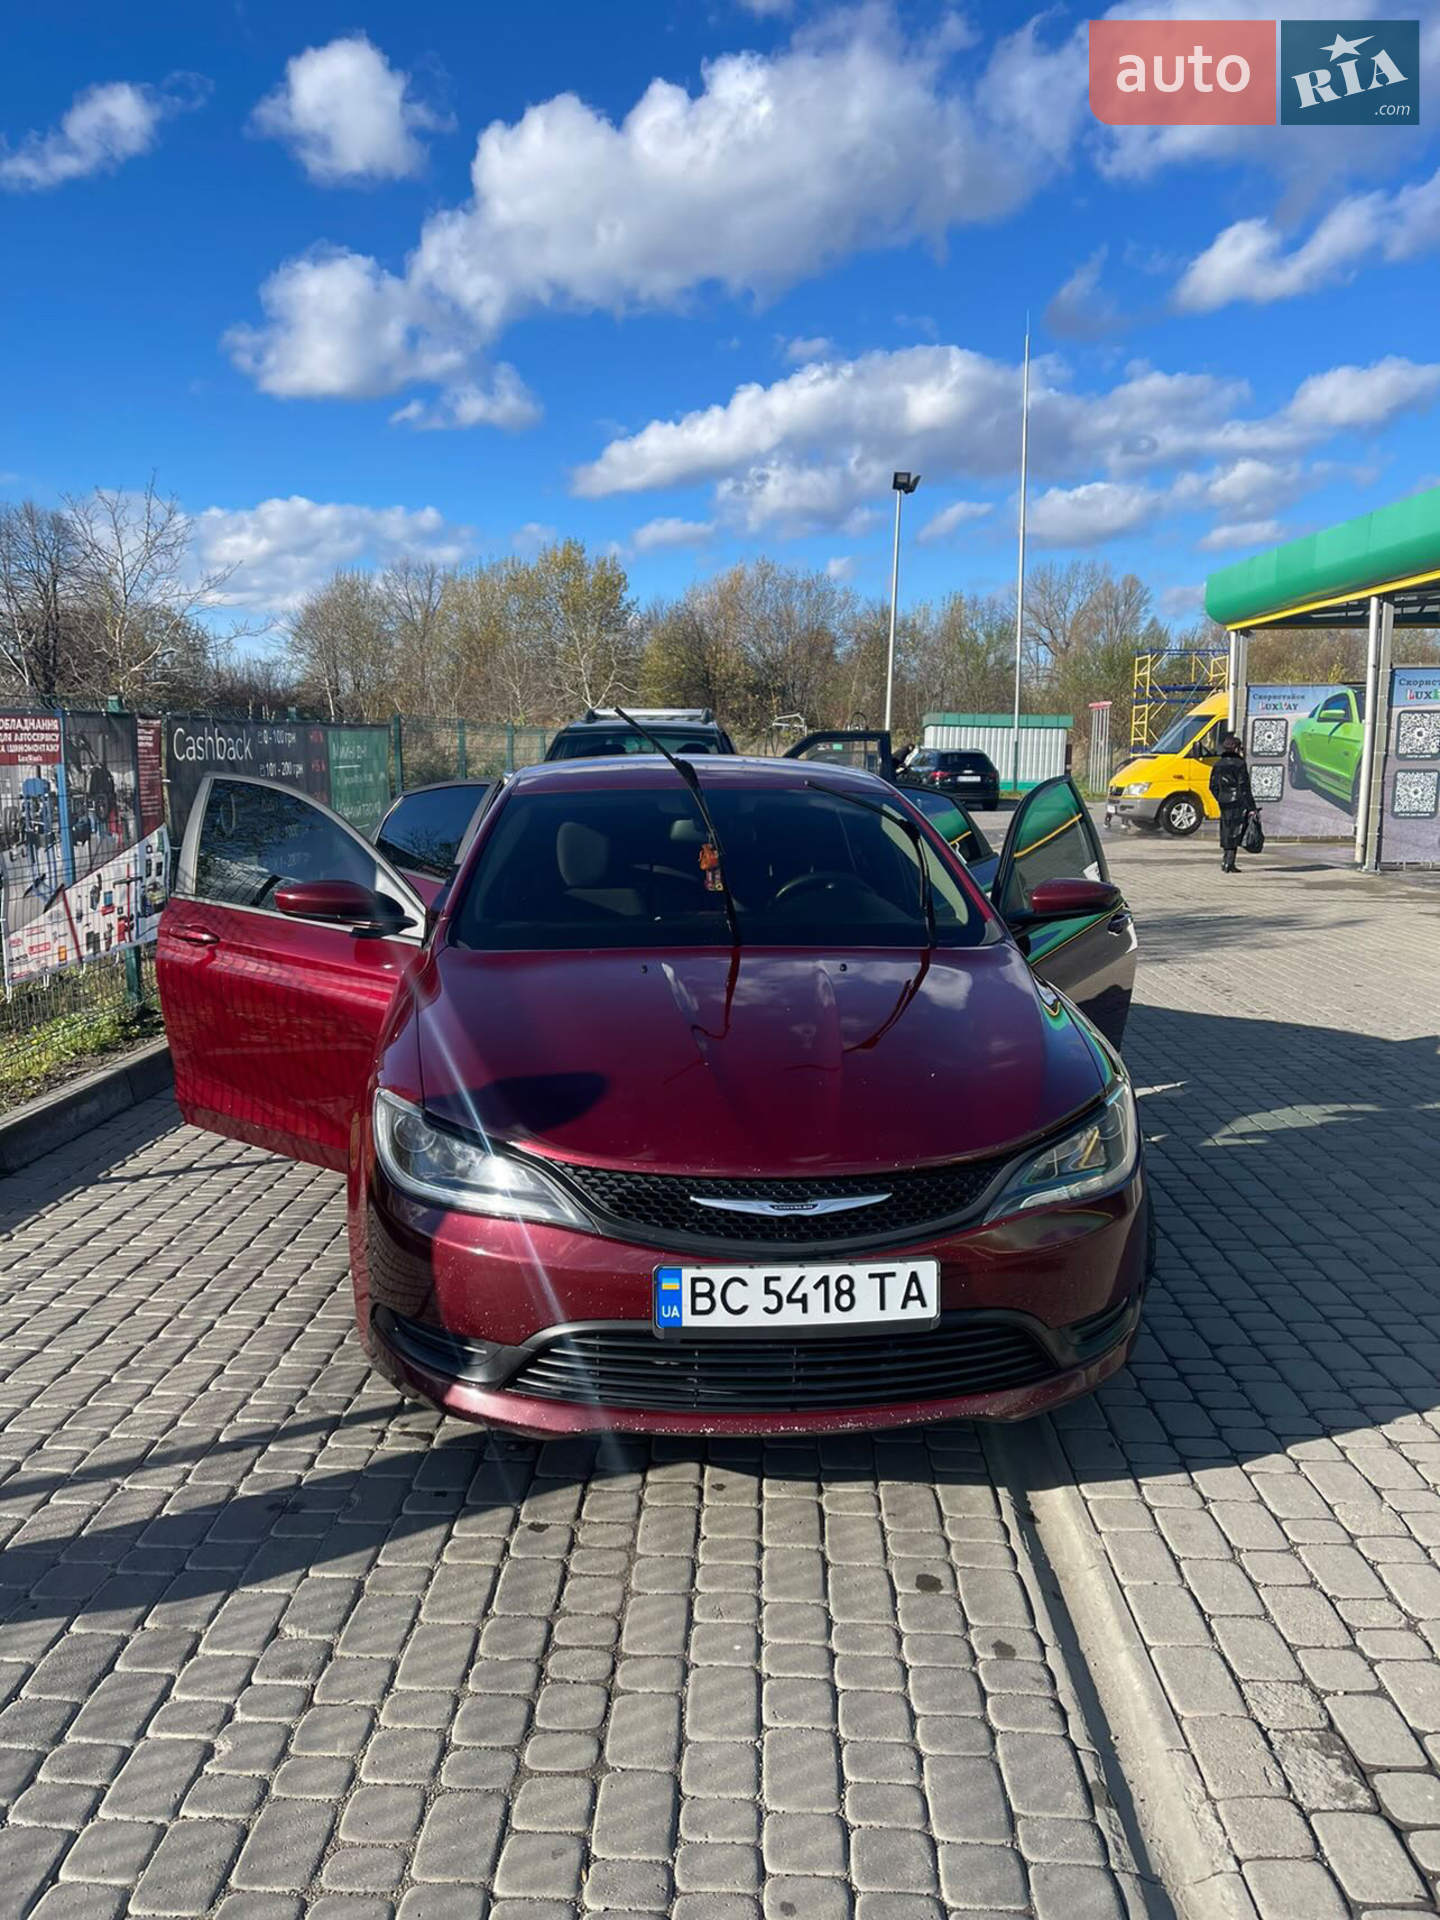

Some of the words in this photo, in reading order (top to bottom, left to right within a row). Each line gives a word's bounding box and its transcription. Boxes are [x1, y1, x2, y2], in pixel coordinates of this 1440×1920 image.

[173, 727, 253, 762] Cashback
[690, 1276, 749, 1316] BC
[762, 1273, 855, 1315] 5418
[868, 1270, 927, 1311] TA
[661, 1305, 680, 1318] UA
